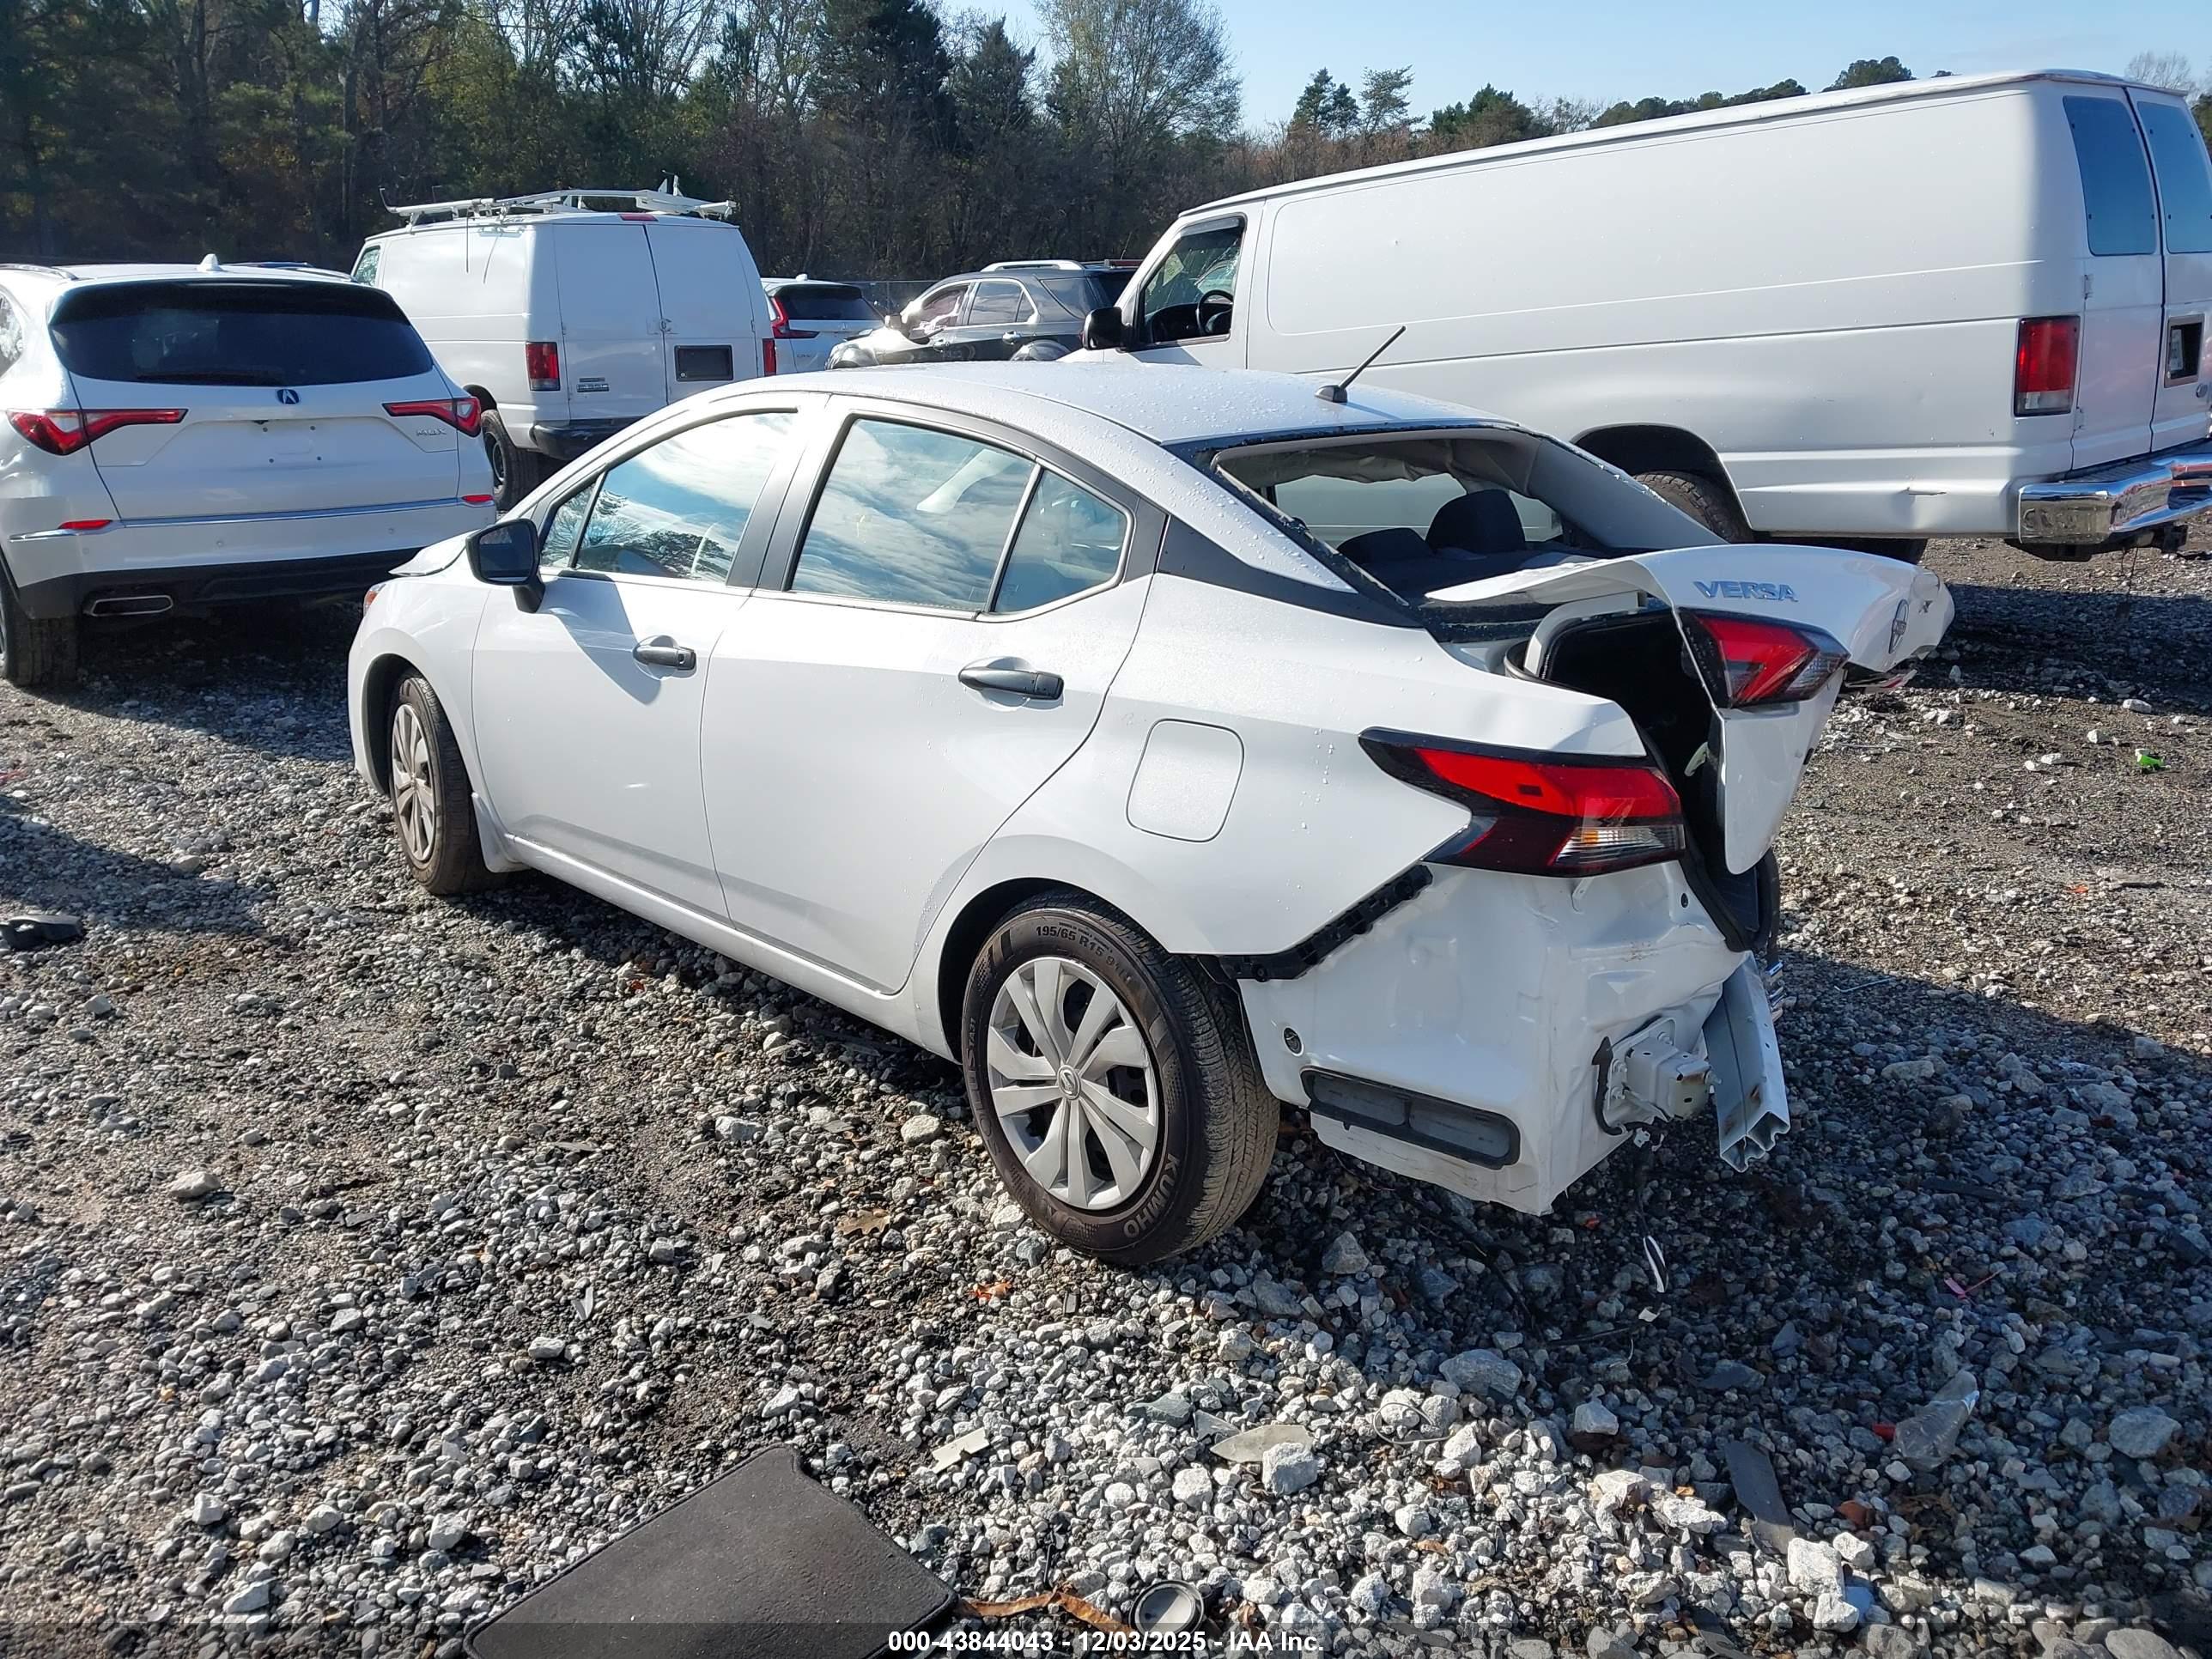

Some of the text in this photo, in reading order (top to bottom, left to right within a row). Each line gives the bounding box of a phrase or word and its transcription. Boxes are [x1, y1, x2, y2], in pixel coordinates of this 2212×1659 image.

[1692, 579, 1799, 602] VERSA
[1036, 925, 1077, 941] 195/65
[1079, 935, 1106, 957] R15
[1123, 1153, 1181, 1239] KUMHO
